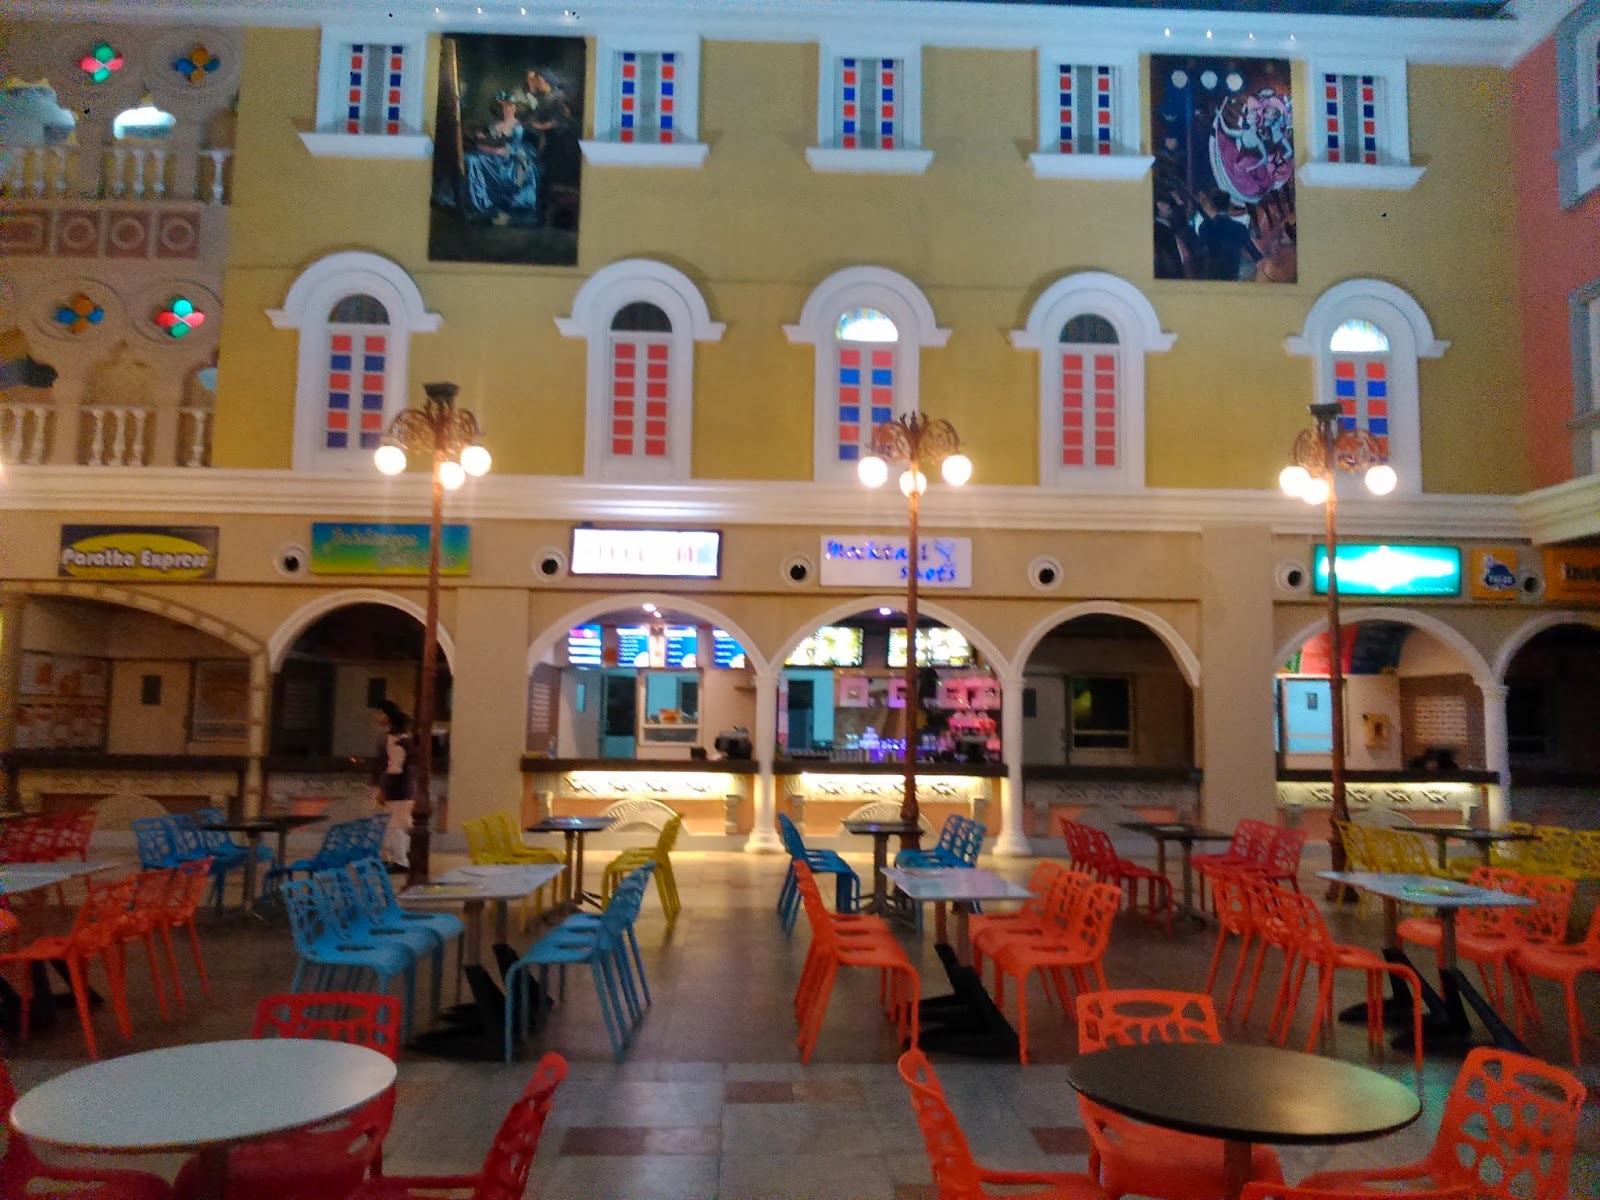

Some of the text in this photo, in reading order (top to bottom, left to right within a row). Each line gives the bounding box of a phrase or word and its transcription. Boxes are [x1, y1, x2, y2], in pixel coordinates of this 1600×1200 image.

[61, 547, 209, 573] Paratha Express
[826, 539, 929, 560] Mocktal
